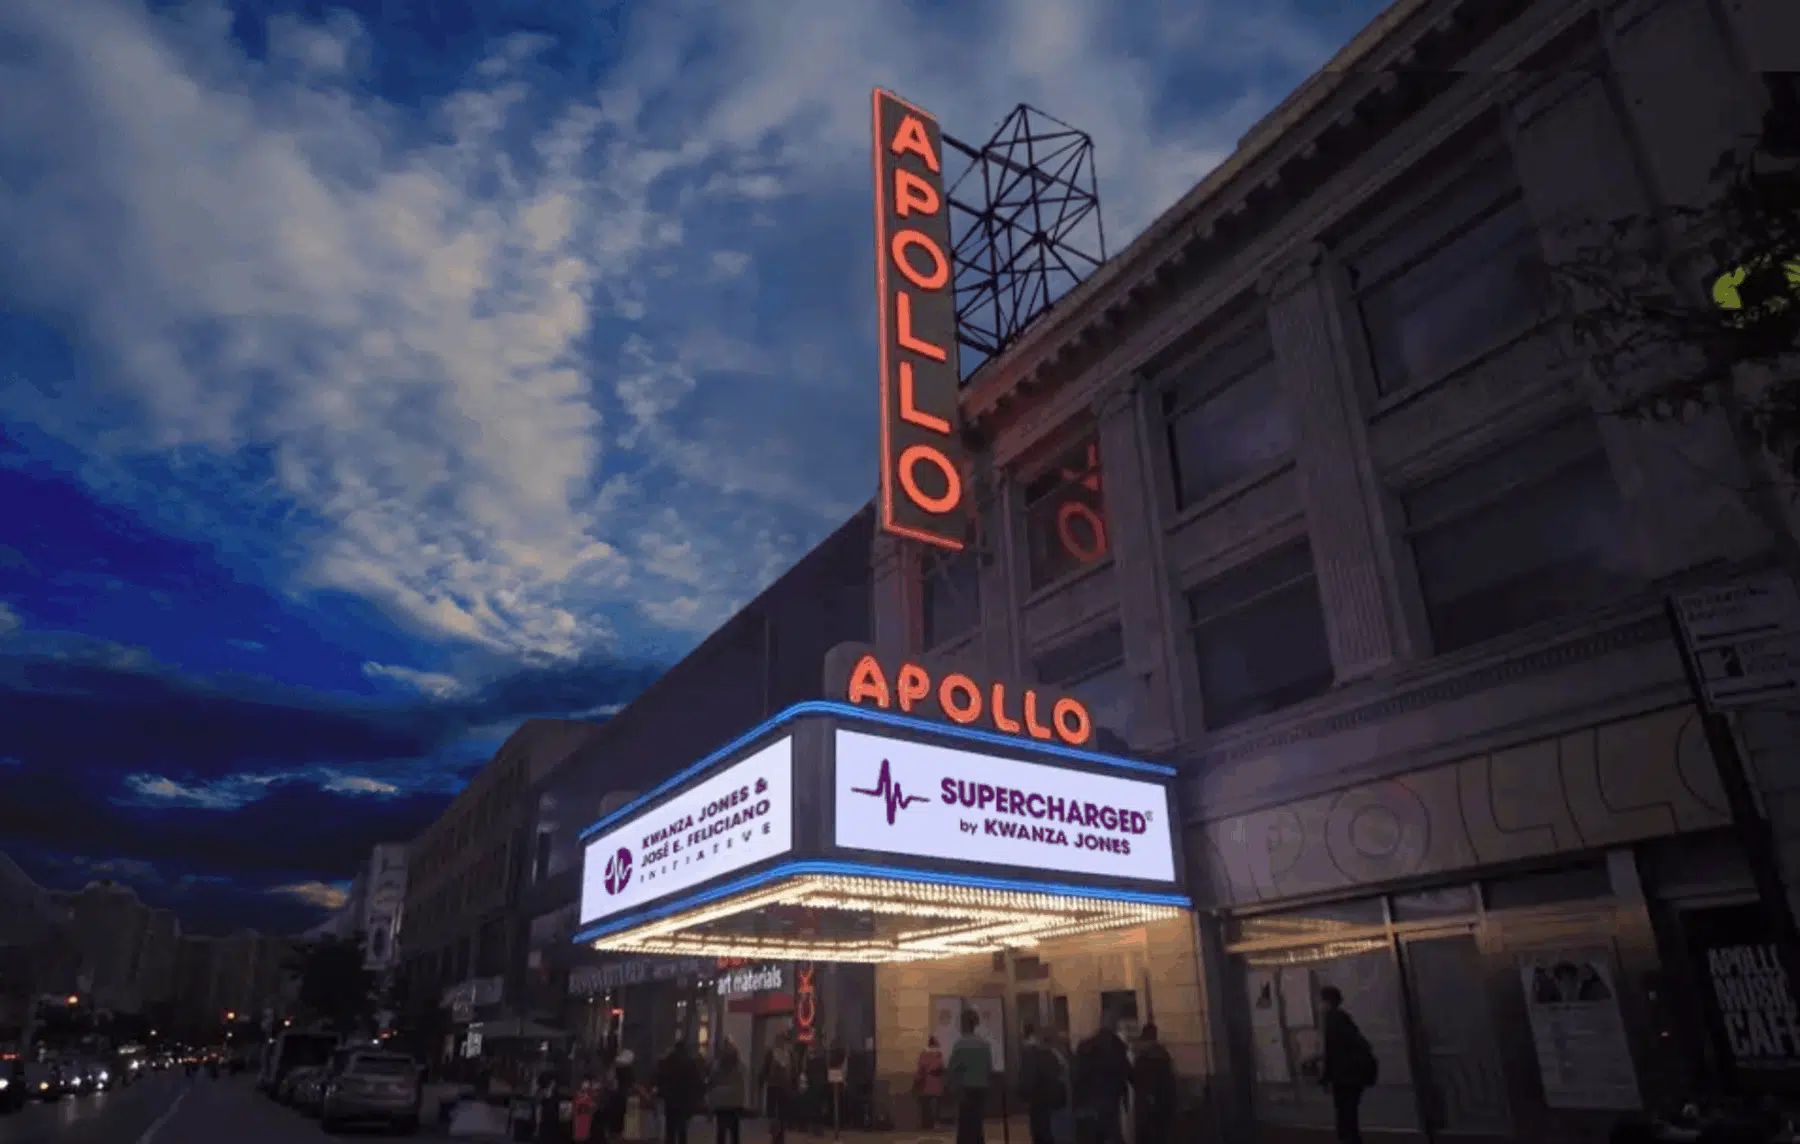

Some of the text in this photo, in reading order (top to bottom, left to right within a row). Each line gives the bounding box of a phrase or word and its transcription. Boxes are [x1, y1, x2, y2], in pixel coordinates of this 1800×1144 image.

[891, 114, 962, 514] APOLLO
[849, 653, 1091, 745] APOLLO
[641, 841, 668, 867] JOSÉ
[688, 799, 770, 847] FELICIANO
[642, 777, 768, 849] KWANZA JONES &
[959, 817, 1131, 855] by KWANZA JONES
[716, 971, 732, 996] art
[733, 963, 782, 993] materials
